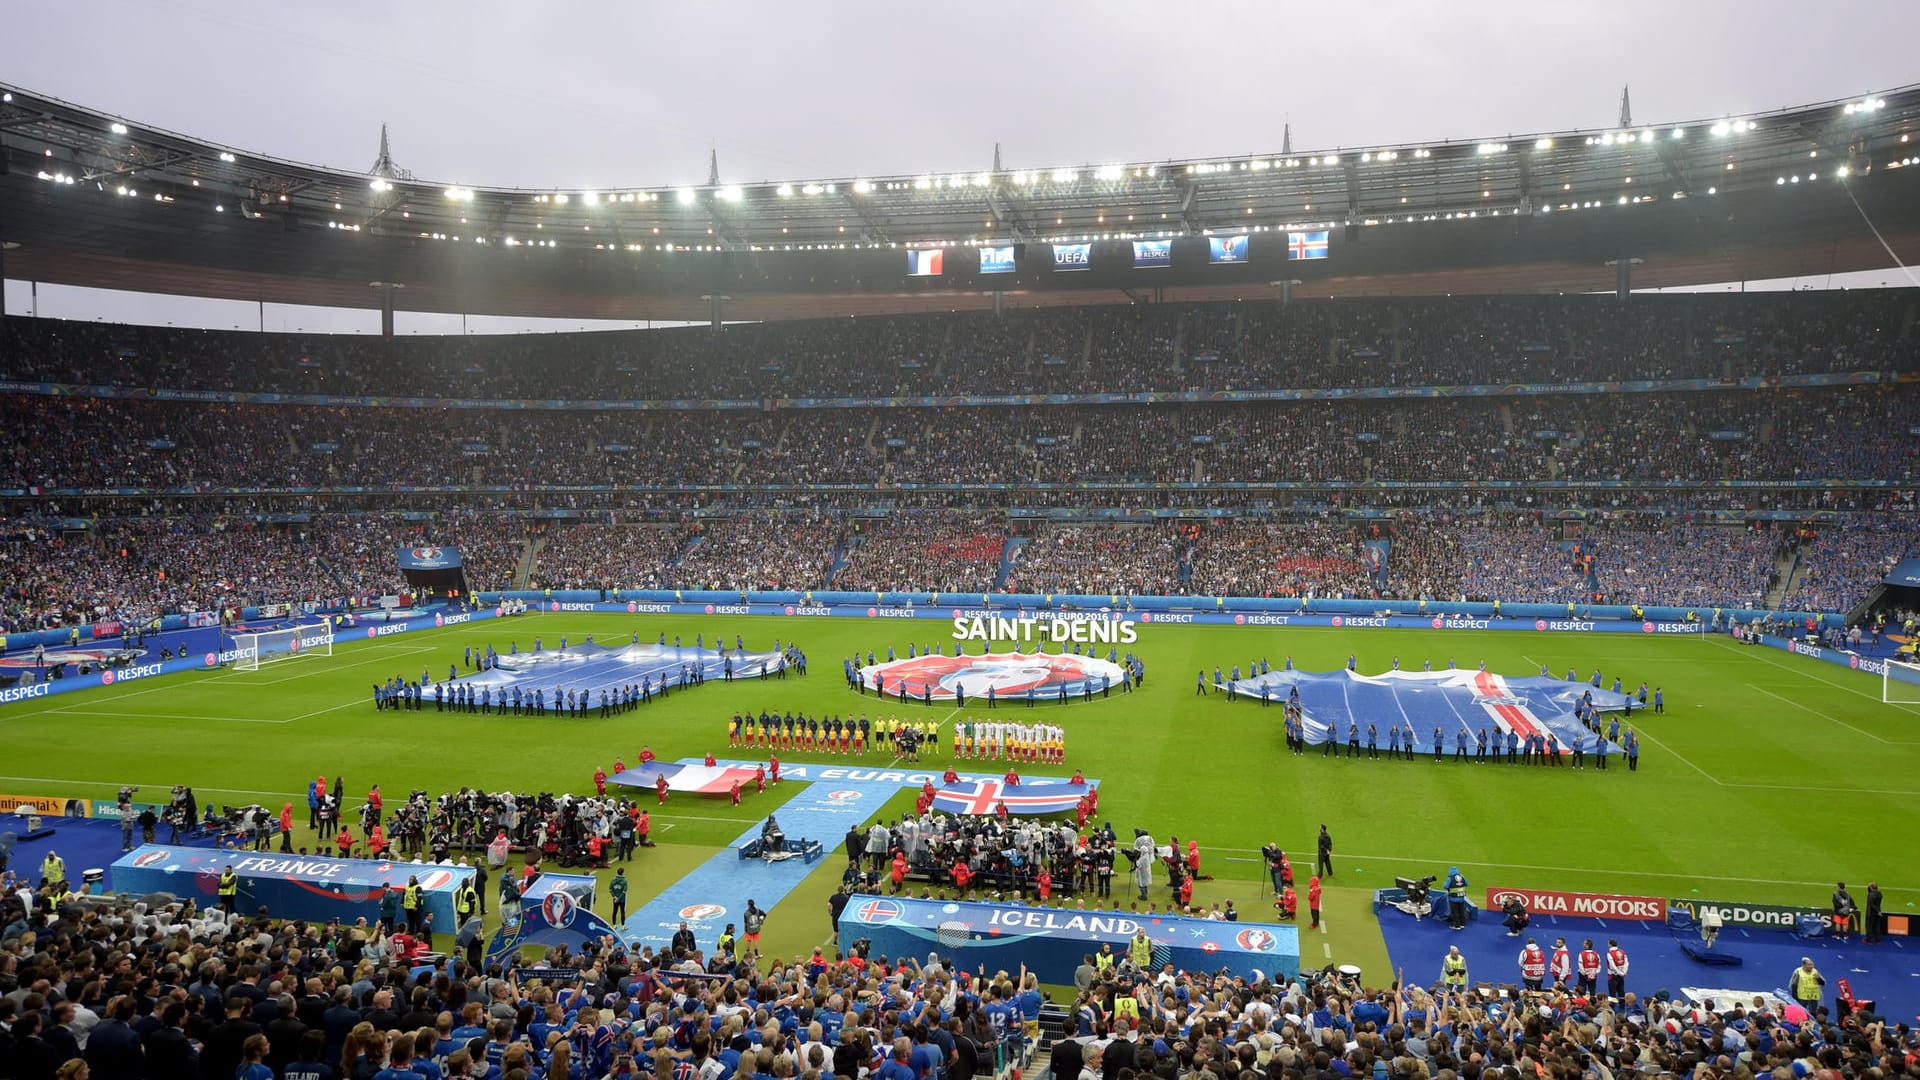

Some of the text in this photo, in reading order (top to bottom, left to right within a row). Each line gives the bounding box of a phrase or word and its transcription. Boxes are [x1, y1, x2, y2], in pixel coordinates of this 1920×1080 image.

[1055, 252, 1088, 263] UEFA
[1143, 250, 1169, 258] RESPECT
[562, 603, 594, 611] RESPECT
[638, 604, 671, 612] RESPECT
[716, 606, 750, 614] RESPECT
[796, 608, 831, 616] RESPECT
[879, 609, 915, 617] RESPECT
[445, 613, 471, 625] RESPECT
[964, 610, 1001, 618] RESPECT
[1032, 612, 1109, 622] UEFA EURO 2016
[1154, 614, 1192, 623] RESPECT
[1248, 616, 1288, 624] RESPECT
[1345, 617, 1387, 627] RESPECT
[1446, 619, 1489, 629] RESPECT
[1550, 622, 1595, 631] RESPECT
[1658, 623, 1699, 633] RESPECT
[378, 623, 408, 635] RESPECT
[952, 618, 1138, 644] SAINT-DENIS
[302, 634, 335, 648] RESPECT
[219, 647, 256, 663] RESPECT
[1795, 643, 1821, 658] RESPECT
[118, 663, 162, 681] RESPECT
[0, 682, 50, 702] RESPECT
[819, 769, 937, 785] EURO
[1, 798, 49, 811] ntinntal
[98, 805, 141, 817] Hisee
[235, 857, 347, 877] FRANCE
[1534, 895, 1660, 918] KIA MOTORS
[988, 908, 1140, 935] ICELAND
[1699, 905, 1832, 928] McDona's
[990, 1012, 1006, 1027] 12
